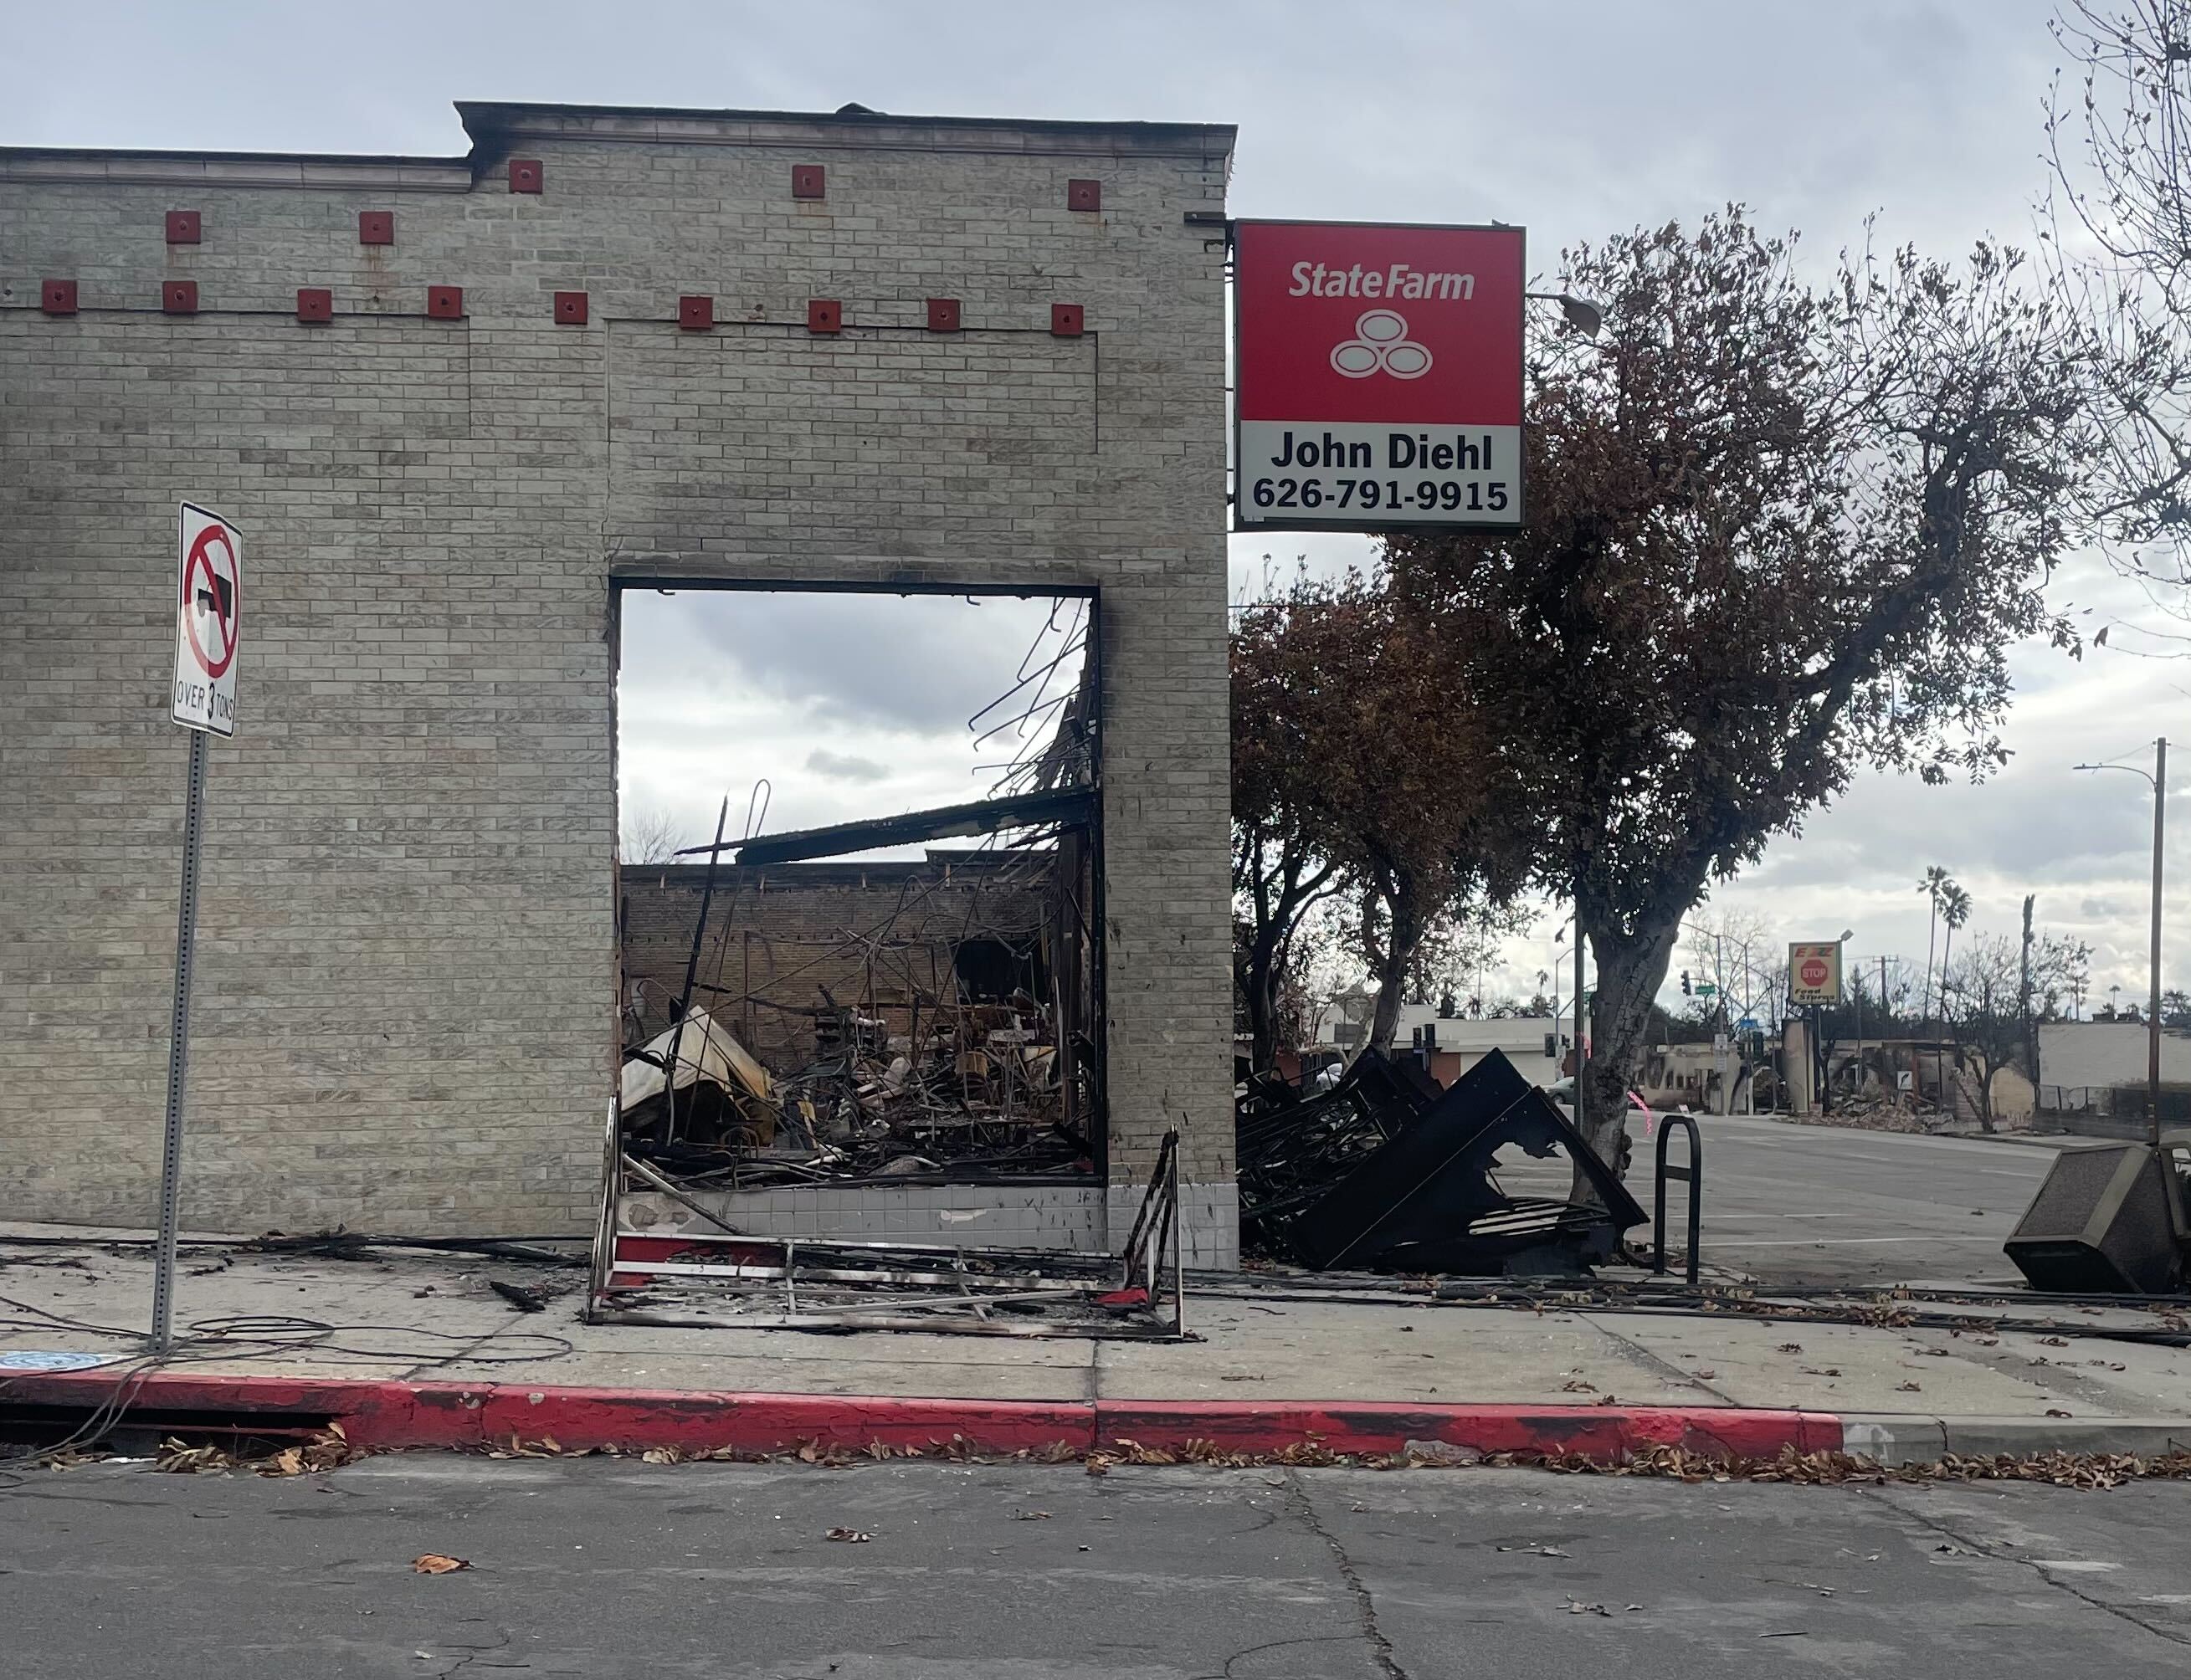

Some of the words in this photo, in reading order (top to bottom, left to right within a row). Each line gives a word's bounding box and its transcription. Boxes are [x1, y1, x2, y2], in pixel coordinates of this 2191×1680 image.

[1270, 431, 1372, 469] John
[1388, 433, 1492, 470] Diehl
[1253, 478, 1508, 511] 626-791-9915
[177, 680, 205, 709] OVER
[207, 682, 215, 720] 3
[217, 693, 233, 720] TONS
[1802, 967, 1826, 978] STOP
